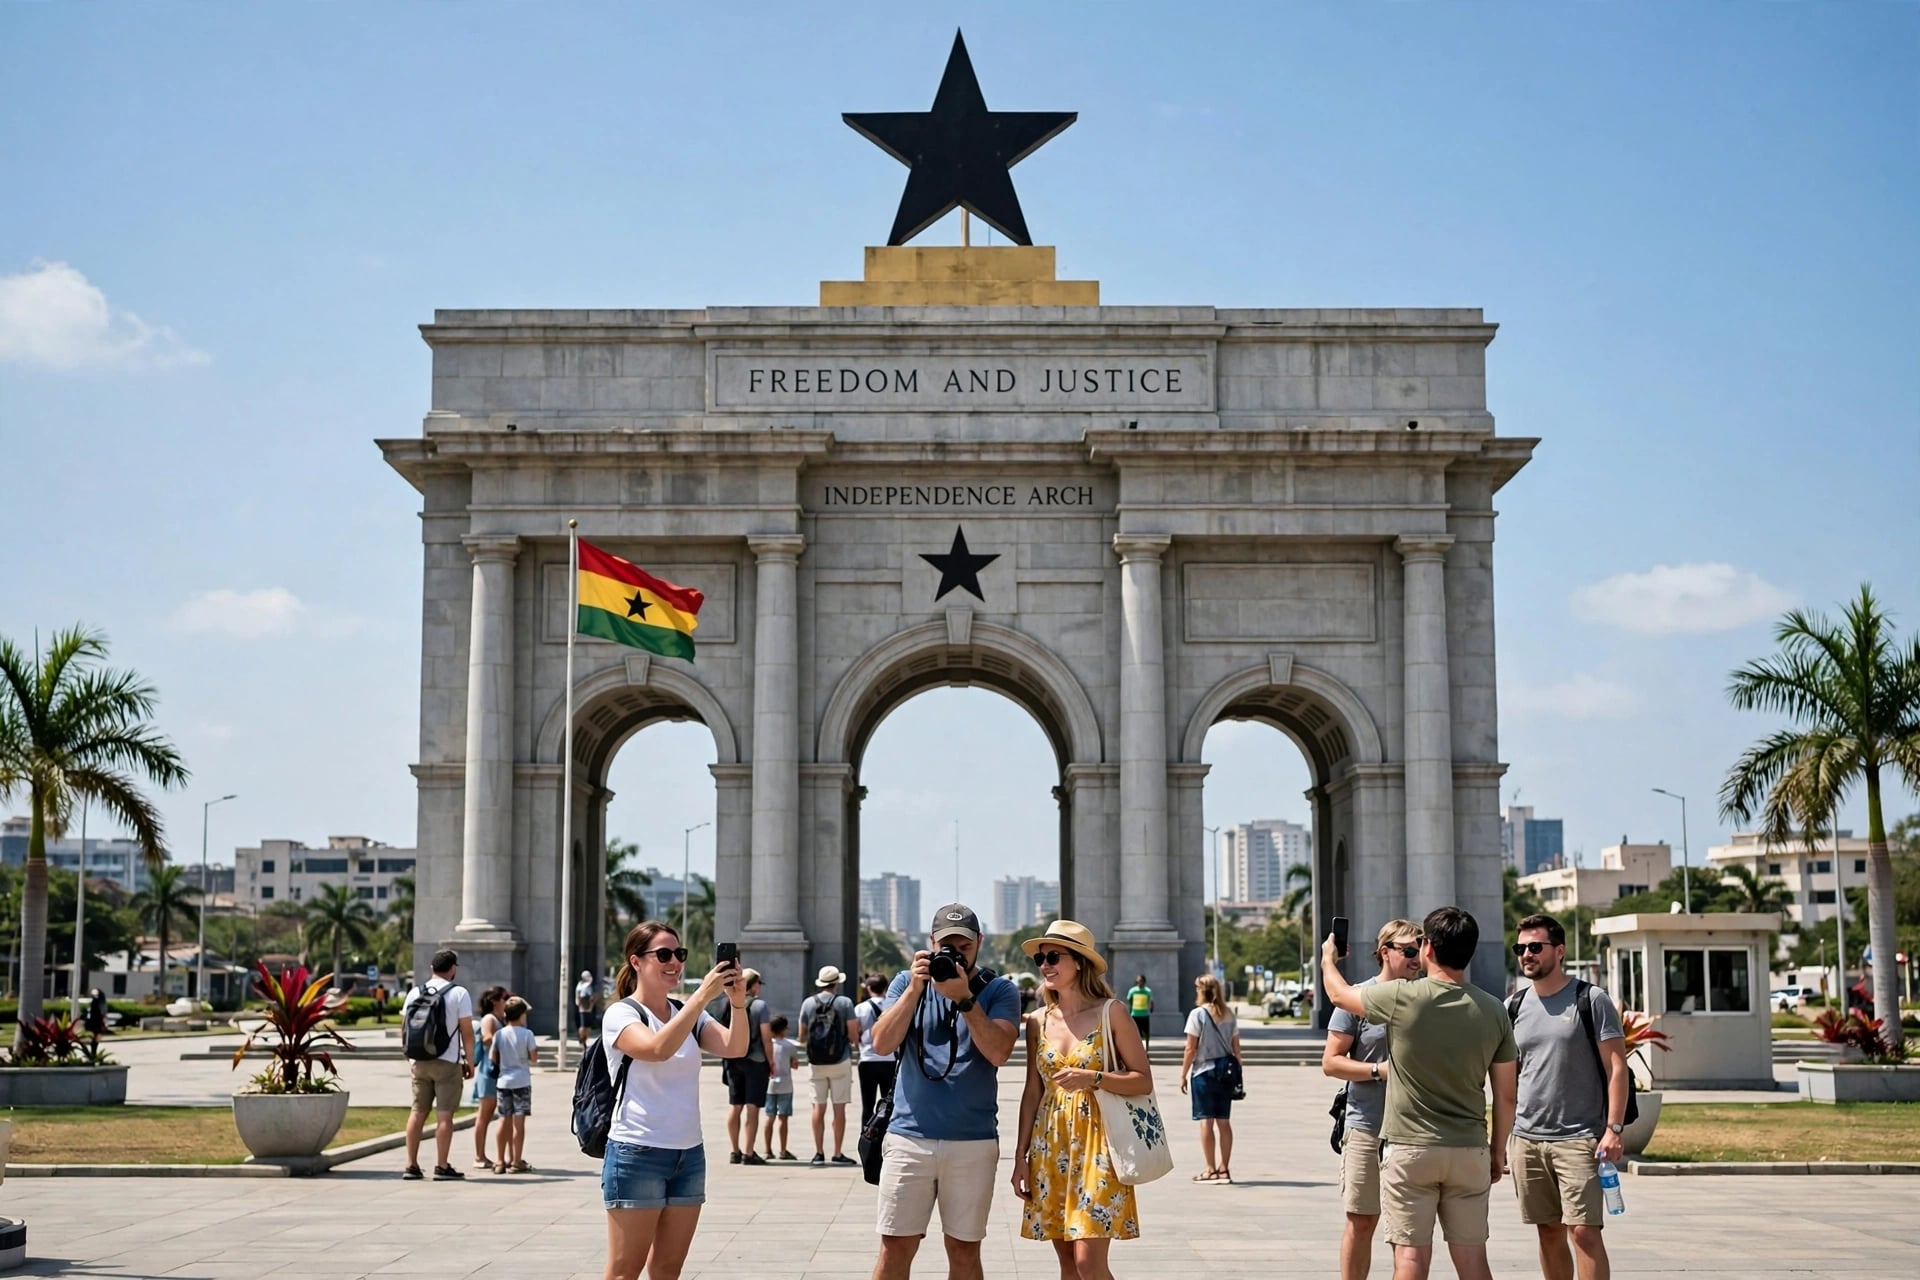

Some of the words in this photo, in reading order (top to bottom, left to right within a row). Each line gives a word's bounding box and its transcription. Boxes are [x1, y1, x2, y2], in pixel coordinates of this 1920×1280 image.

[749, 368, 919, 393] FREEDOM
[943, 368, 1016, 393] AND
[1040, 368, 1182, 393] JUSTICE
[824, 486, 1017, 506] INDEPENDENCE
[1027, 486, 1094, 506] ARCH
